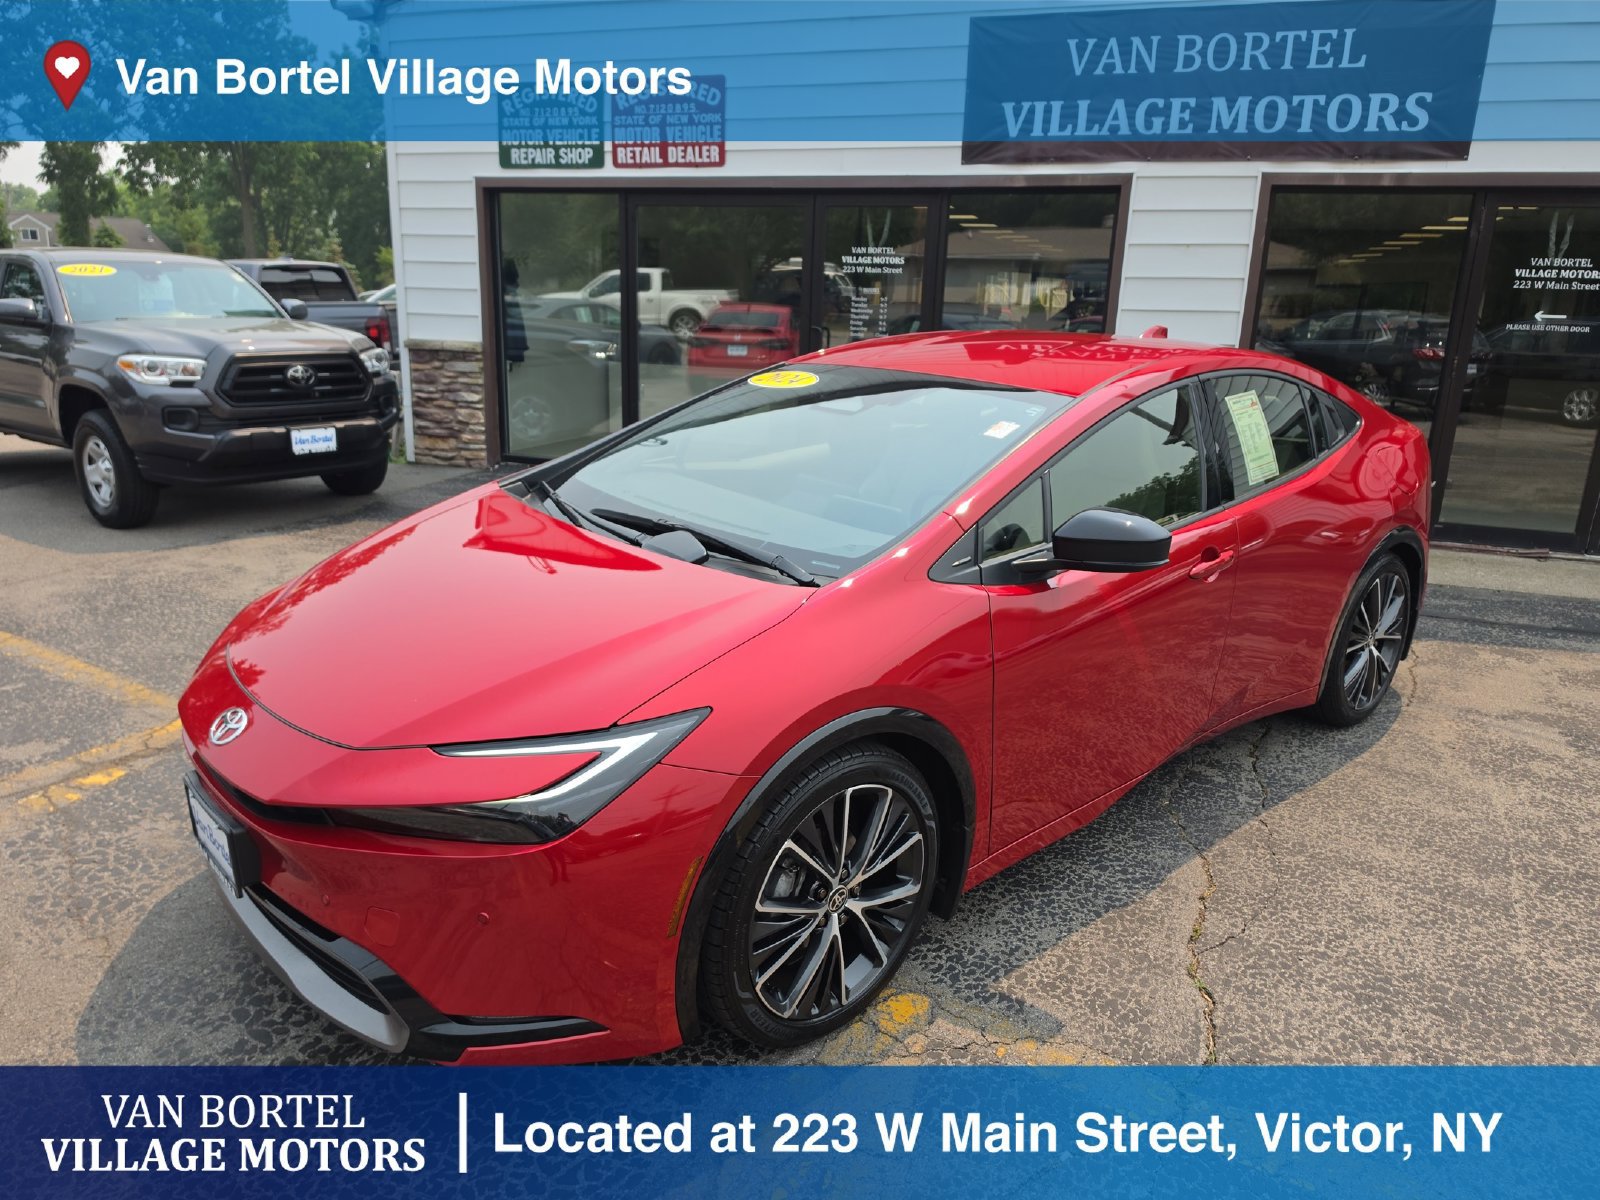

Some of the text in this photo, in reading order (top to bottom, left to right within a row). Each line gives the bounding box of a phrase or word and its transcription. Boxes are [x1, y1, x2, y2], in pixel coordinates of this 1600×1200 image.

[1067, 28, 1367, 75] VAN BORTEL
[614, 113, 722, 125] STATE OF NEW YORK
[1002, 92, 1432, 138] VILLAGE MOTORS
[503, 116, 598, 127] STATE OF NEW YORK
[502, 128, 600, 146] MOTOR VEHICLE
[614, 125, 722, 144] MOTOR VEHICLE
[511, 147, 593, 164] REPAIR SHOP
[617, 145, 719, 163] RETAIL DEALER
[842, 256, 905, 265] VILLAGE MOTORS
[1531, 258, 1593, 268] VAN BORTEL
[842, 265, 855, 273] 223
[1515, 269, 1558, 278] VILLAGE
[1513, 280, 1600, 290] 223 W Main Street
